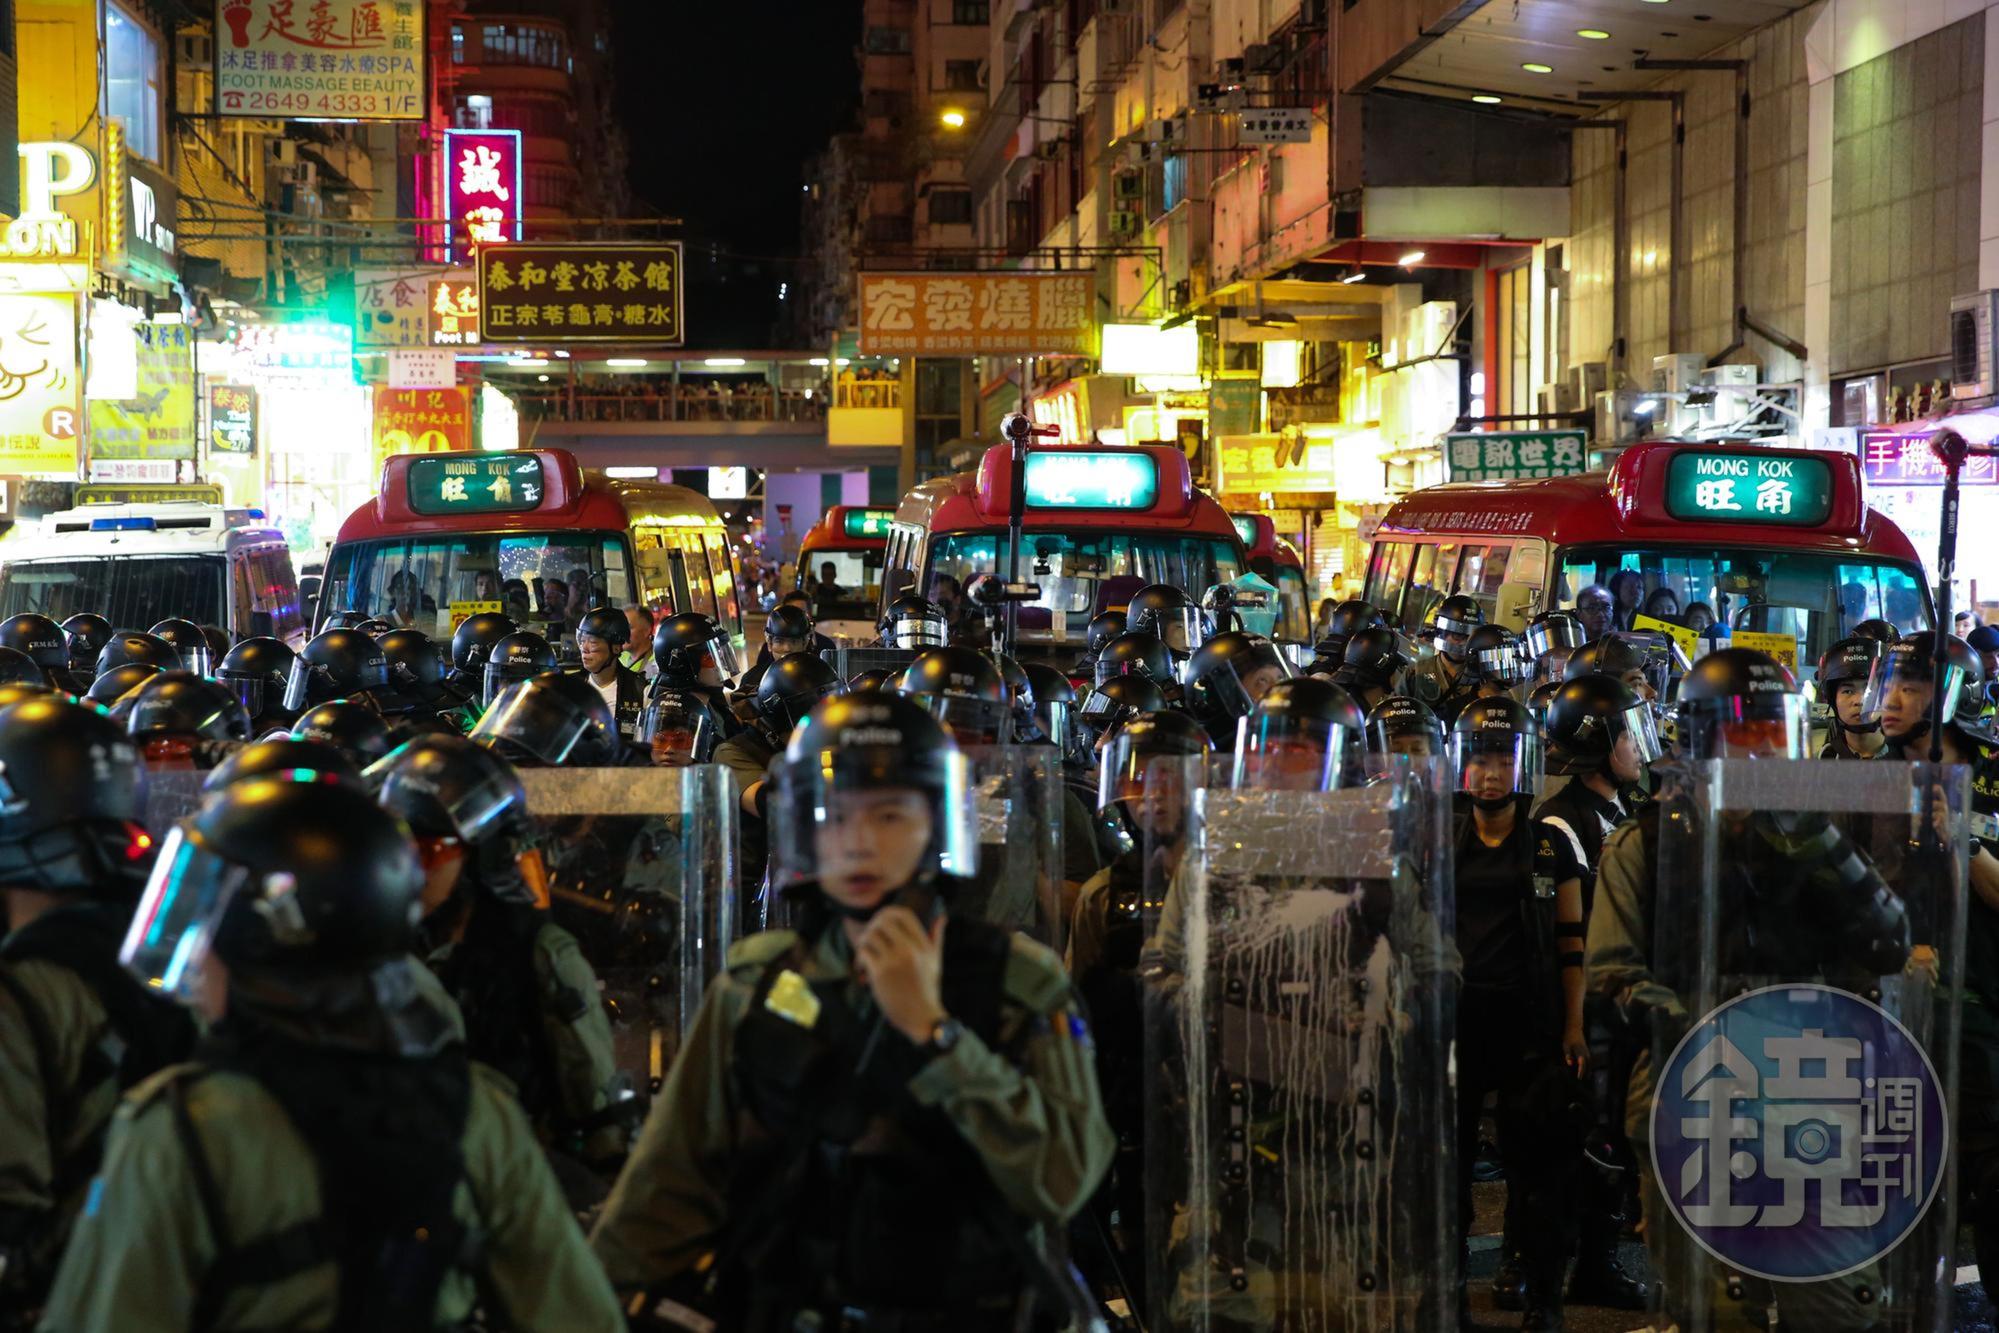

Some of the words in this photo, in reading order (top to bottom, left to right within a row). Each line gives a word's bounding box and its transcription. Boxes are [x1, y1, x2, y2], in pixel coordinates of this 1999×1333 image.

[221, 74, 265, 88] FOOT
[269, 76, 348, 91] MASSAGE
[352, 78, 415, 92] BEAUTY
[250, 92, 310, 110] 2649
[317, 94, 376, 113] 4333
[384, 96, 417, 113] 1/F
[865, 279, 1090, 331] 宏發燒臘
[51, 410, 75, 435] R
[445, 463, 477, 475] MONG
[488, 463, 511, 475] KOK
[1697, 459, 1749, 478] MONG
[1757, 461, 1794, 479] KOK
[1696, 479, 1793, 515] 旺角
[508, 656, 532, 664] Police
[1843, 655, 1868, 663] Police
[1749, 681, 1785, 691] Police
[660, 700, 683, 708] Police
[1390, 708, 1416, 716] Police
[1482, 720, 1512, 730] Police
